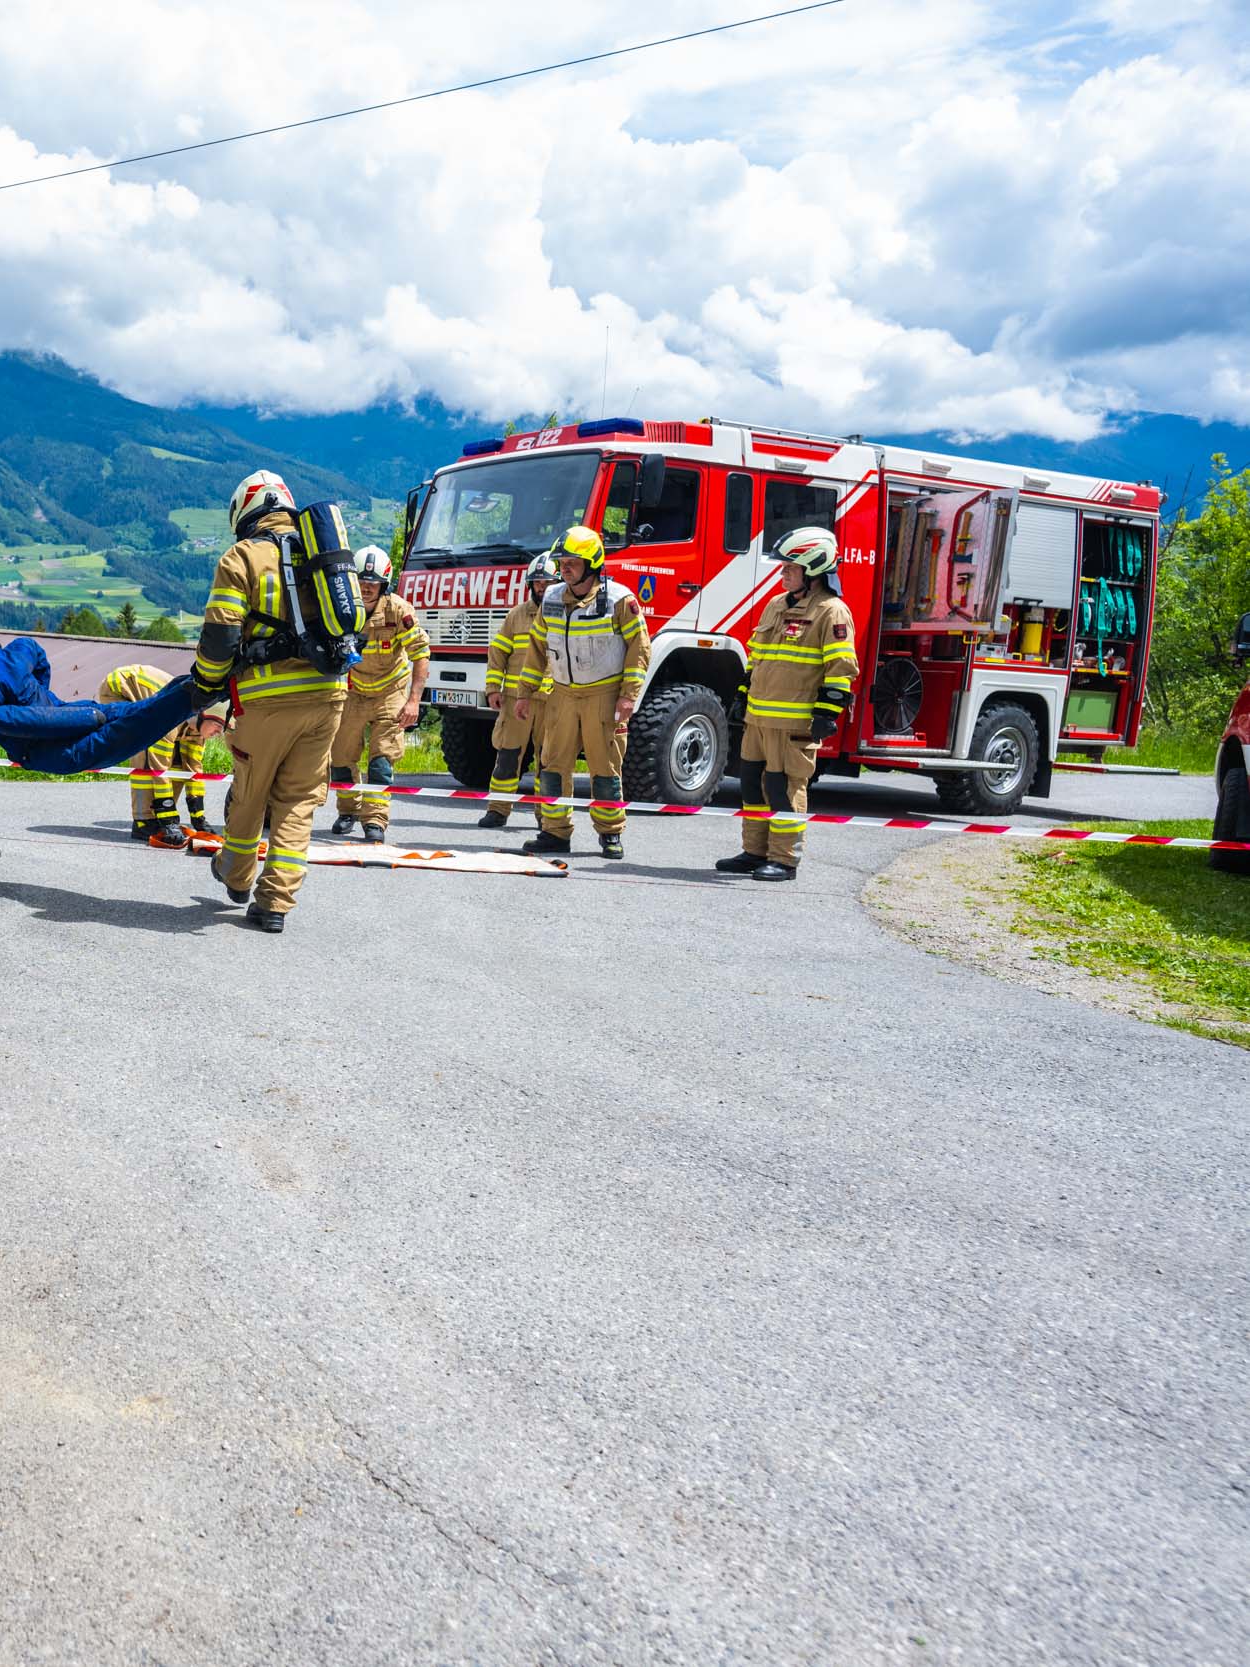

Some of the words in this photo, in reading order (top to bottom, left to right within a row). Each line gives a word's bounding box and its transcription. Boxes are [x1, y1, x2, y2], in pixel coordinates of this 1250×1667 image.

[536, 429, 562, 447] 122
[844, 547, 876, 565] LFA-B
[334, 576, 351, 614] AXAMS
[403, 569, 530, 607] FEUERWEH
[452, 692, 464, 703] 317
